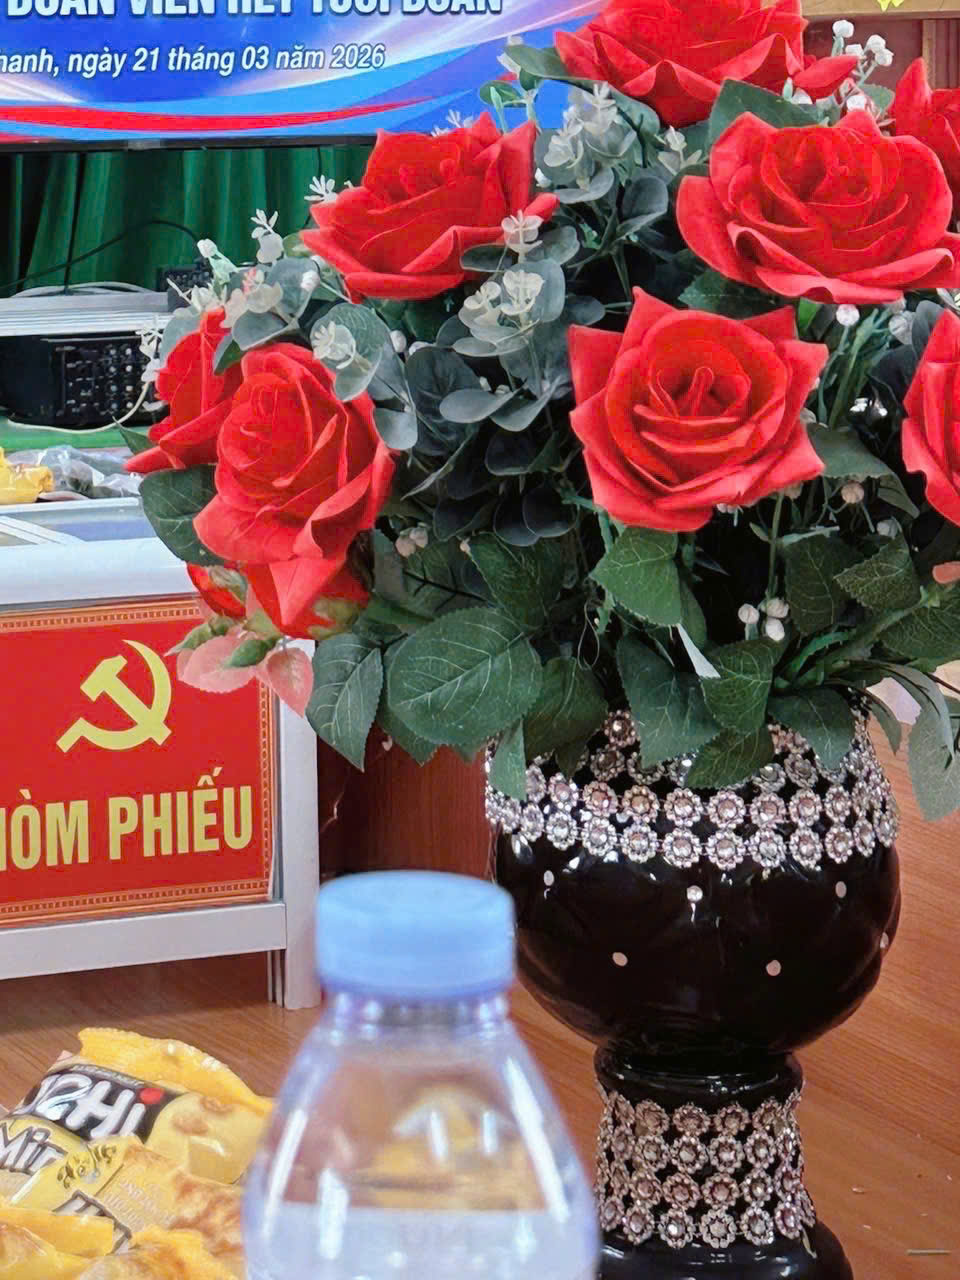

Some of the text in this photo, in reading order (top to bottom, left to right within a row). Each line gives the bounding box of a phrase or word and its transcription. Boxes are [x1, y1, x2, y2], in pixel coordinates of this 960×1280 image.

[68, 46, 126, 78] ngày
[133, 48, 160, 71] 21
[168, 45, 237, 75] tháng
[242, 47, 269, 70] 03
[276, 44, 325, 69] năm
[329, 44, 385, 69] 2026
[108, 766, 253, 861] PHIẾU
